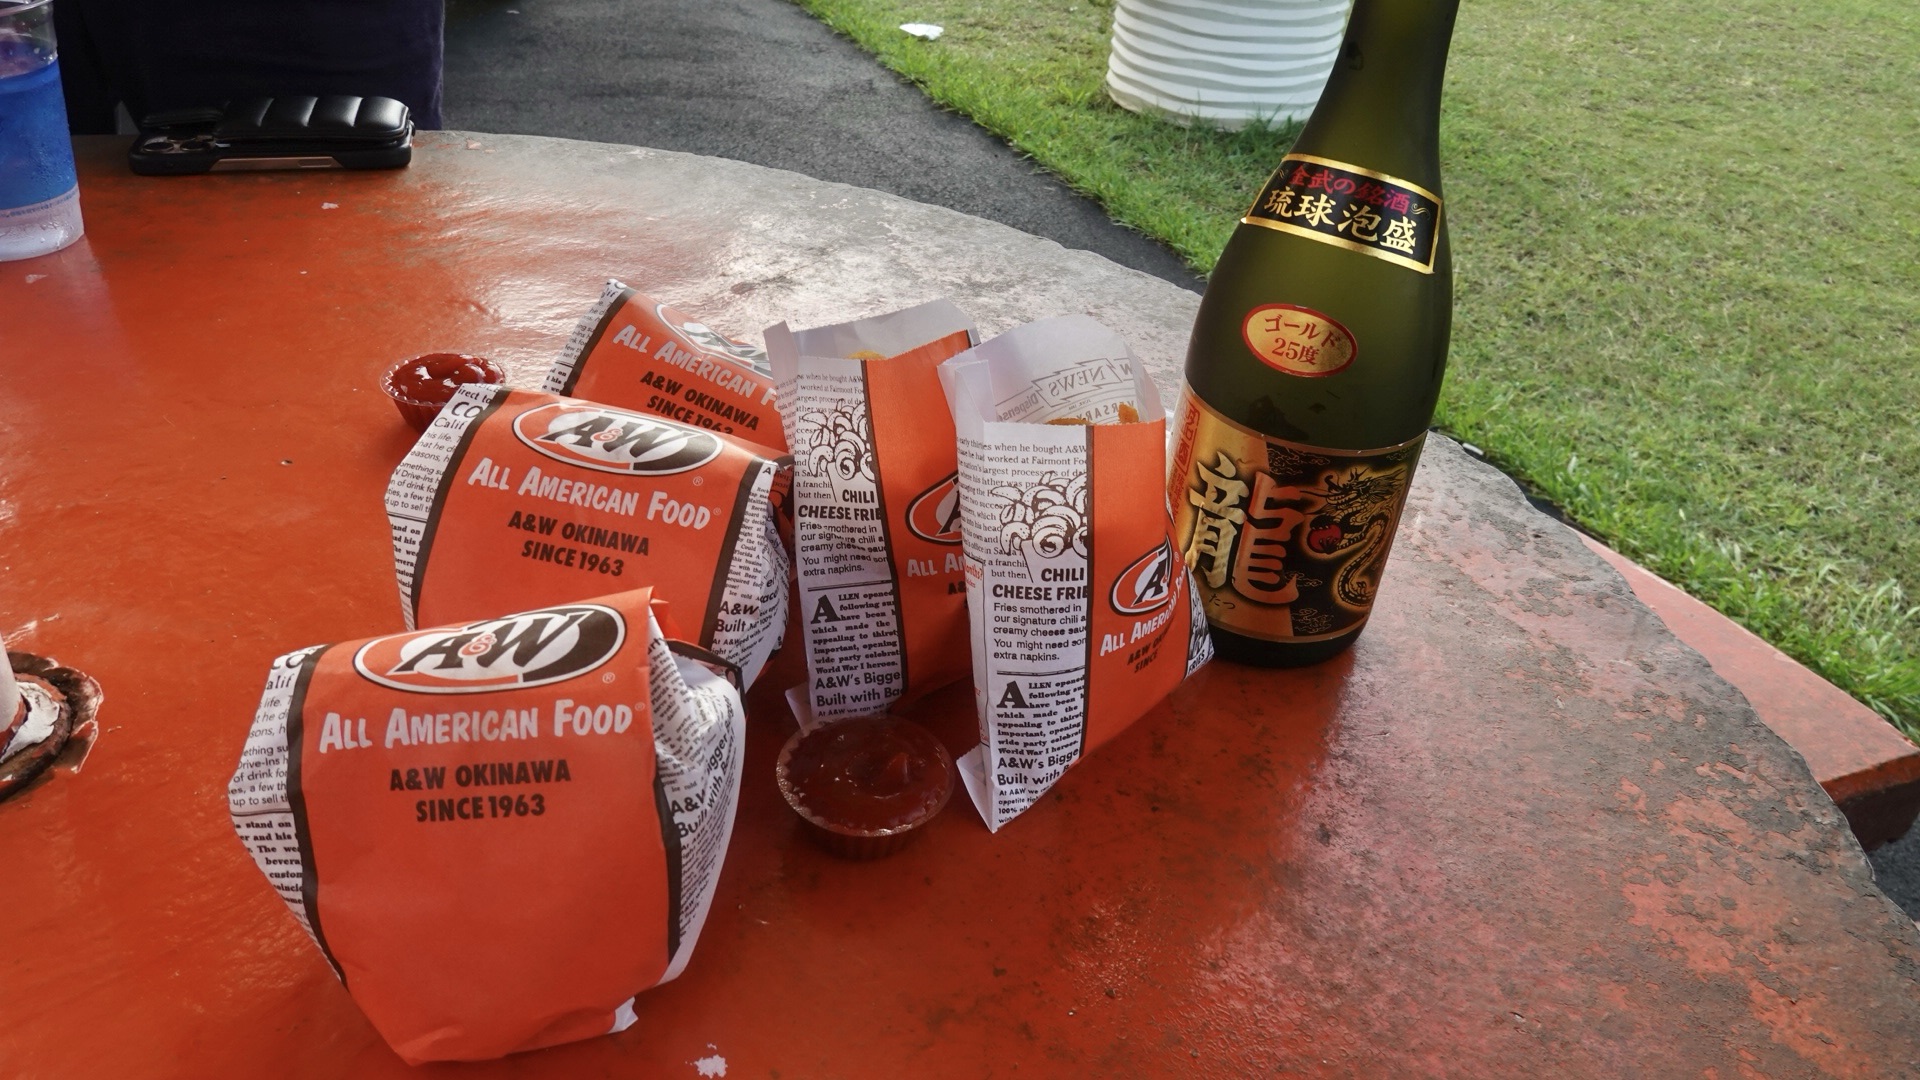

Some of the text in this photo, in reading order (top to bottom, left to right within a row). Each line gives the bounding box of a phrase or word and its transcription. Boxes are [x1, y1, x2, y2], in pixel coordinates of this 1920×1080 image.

[1289, 164, 1411, 215] 金武の銘酒
[1263, 186, 1417, 255] 琉球泡盛
[1264, 314, 1342, 348] ゴールド
[1271, 337, 1320, 366] 25度
[613, 325, 652, 354] ALL
[654, 340, 758, 399] AMERICAN
[640, 371, 687, 396] A&W
[684, 388, 760, 431] OKINAWA
[646, 395, 692, 423] SINCE
[534, 414, 701, 461] A&W
[994, 442, 1018, 452] when
[1020, 444, 1030, 453] he
[1033, 444, 1063, 455] bought
[987, 455, 1019, 465] worked
[1032, 456, 1071, 465] Fairmont
[401, 469, 434, 484] Drive-Ins
[1061, 468, 1070, 477] of
[406, 480, 425, 491] drink
[468, 457, 511, 490] ALL
[518, 466, 640, 517] AMERICAN
[646, 491, 711, 531] FOOD
[798, 490, 831, 499] but then
[842, 489, 875, 504] CHILI
[798, 504, 852, 520] CHEESE
[508, 510, 650, 556] A&W OKINAWA
[799, 521, 877, 533] Fries in
[1189, 451, 1306, 605] 龍
[801, 533, 876, 544] our chili
[801, 542, 834, 553] creamy
[521, 540, 624, 578] SINCE 1963
[803, 553, 871, 566] You might need
[803, 563, 865, 577] extra napkins.
[907, 558, 938, 578] ALL
[991, 569, 1027, 579] but then
[1041, 567, 1085, 582] CHILI
[992, 584, 1052, 601] CHEESE
[811, 594, 840, 624] A
[840, 601, 880, 611] following
[993, 602, 1081, 614] Fries smothered in
[865, 611, 886, 619] been
[994, 614, 1078, 627] our signature chili
[812, 620, 890, 634] which made the
[993, 626, 1066, 637] creamy cheese
[386, 608, 596, 677] A&W
[813, 632, 868, 645] appealing to
[993, 638, 1069, 651] You might need
[1100, 632, 1126, 657] ALL
[814, 639, 897, 655] important, opening
[815, 653, 861, 664] wide party
[993, 651, 1060, 663] extra napkins.
[815, 665, 841, 674] World
[842, 664, 859, 672] War
[866, 660, 898, 669] heroes.
[815, 671, 901, 690] A&W's Bigge
[816, 687, 900, 707] Built with Ba
[996, 680, 1030, 708] A
[1028, 689, 1071, 699] following
[1055, 697, 1076, 706] been
[1033, 710, 1058, 718] made
[1065, 705, 1078, 713] the
[319, 698, 632, 753] ALL AMERICAN FOOD
[997, 721, 1043, 729] appealing
[997, 721, 1081, 738] important, opening
[998, 738, 1047, 748] wide party
[998, 747, 1024, 755] World
[1051, 740, 1079, 753] heroes.
[997, 757, 1045, 769] A&W's
[1047, 748, 1079, 767] Bigge
[233, 768, 273, 783] of drink
[390, 759, 572, 791] A&W OKINAWA
[997, 769, 1060, 786] Built with
[259, 782, 274, 792] few
[233, 793, 279, 808] up to sell
[416, 793, 546, 823] SINCE 1963
[246, 820, 273, 829] stand
[253, 832, 292, 841] and his
[256, 845, 277, 853] The
